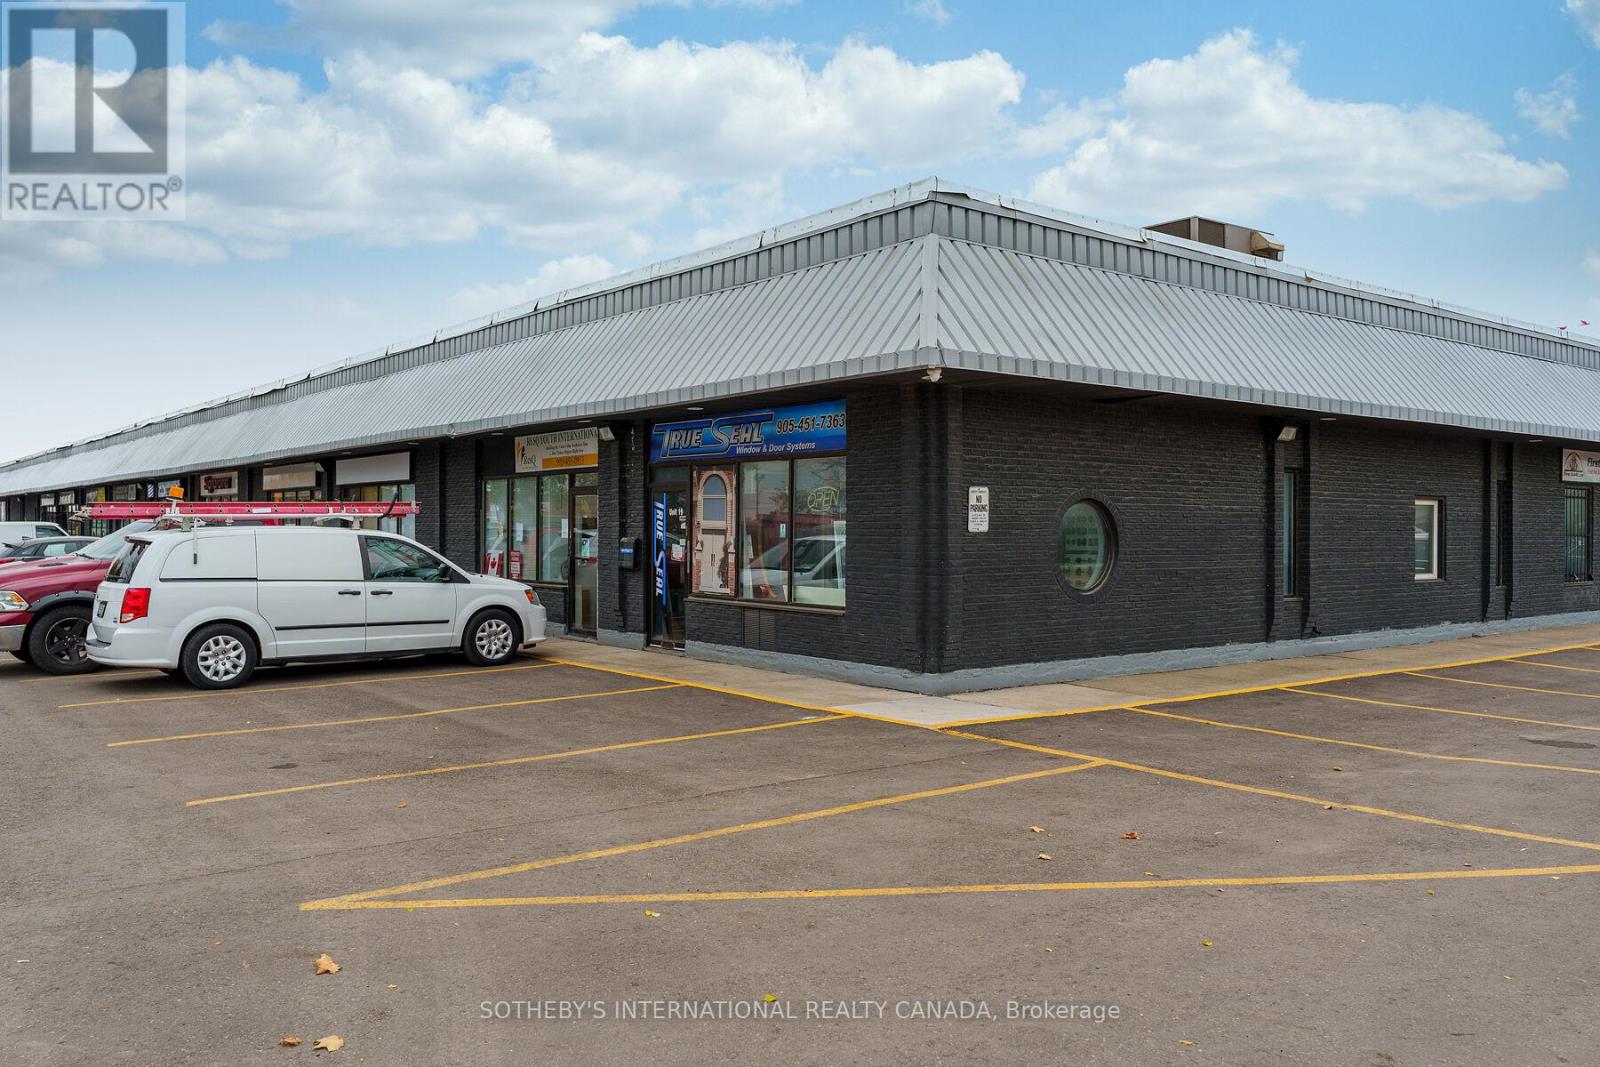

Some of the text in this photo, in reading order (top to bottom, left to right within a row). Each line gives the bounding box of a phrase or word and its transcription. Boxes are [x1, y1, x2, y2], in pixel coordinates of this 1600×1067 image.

[776, 412, 846, 435] 905-451-7363
[558, 429, 598, 442] INTERNATIONA
[736, 442, 816, 455] Window & Door Systems
[808, 490, 839, 507] OPEN
[975, 495, 983, 503] NO
[970, 504, 988, 512] PARKING
